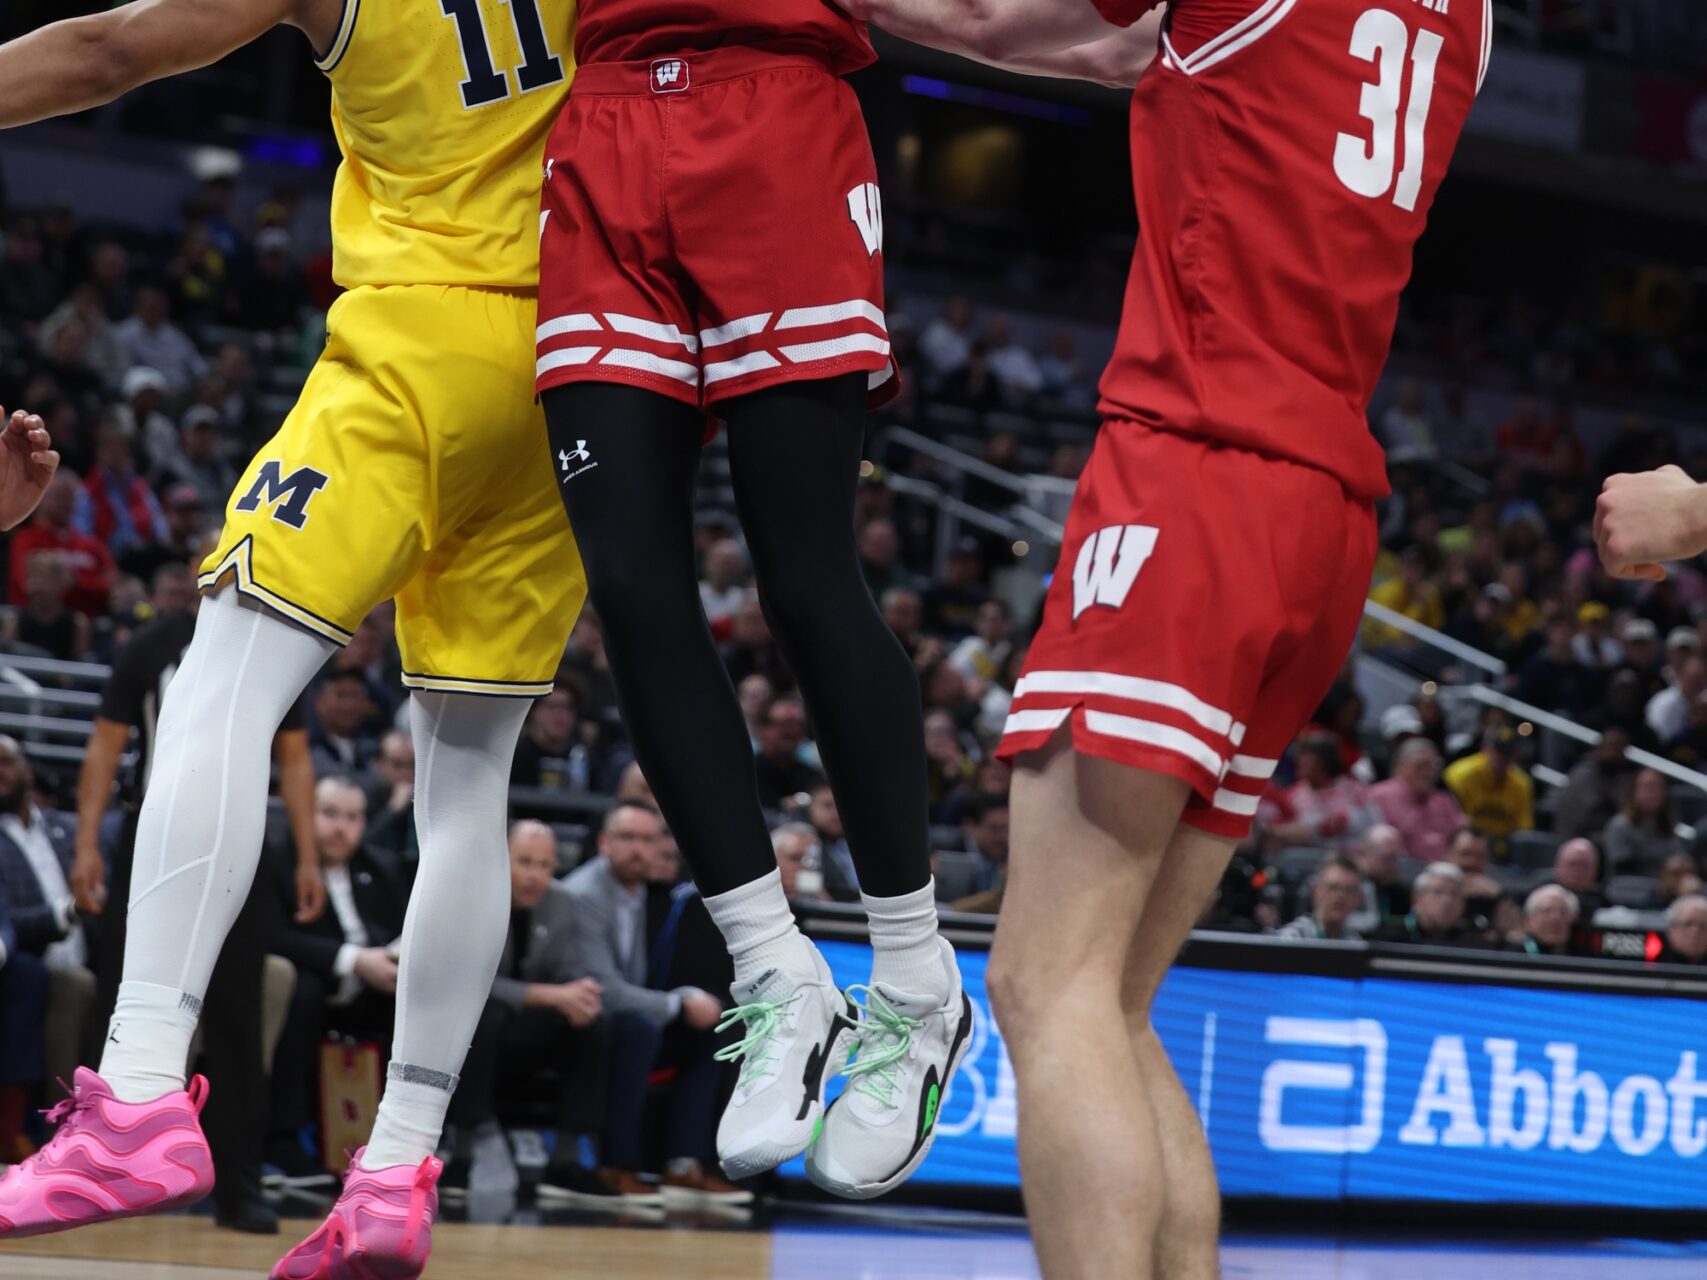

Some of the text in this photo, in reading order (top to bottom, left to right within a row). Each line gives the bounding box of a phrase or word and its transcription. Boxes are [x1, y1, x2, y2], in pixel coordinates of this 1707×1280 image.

[1332, 8, 1445, 212] 31
[234, 459, 330, 532] M
[1072, 524, 1160, 621] W
